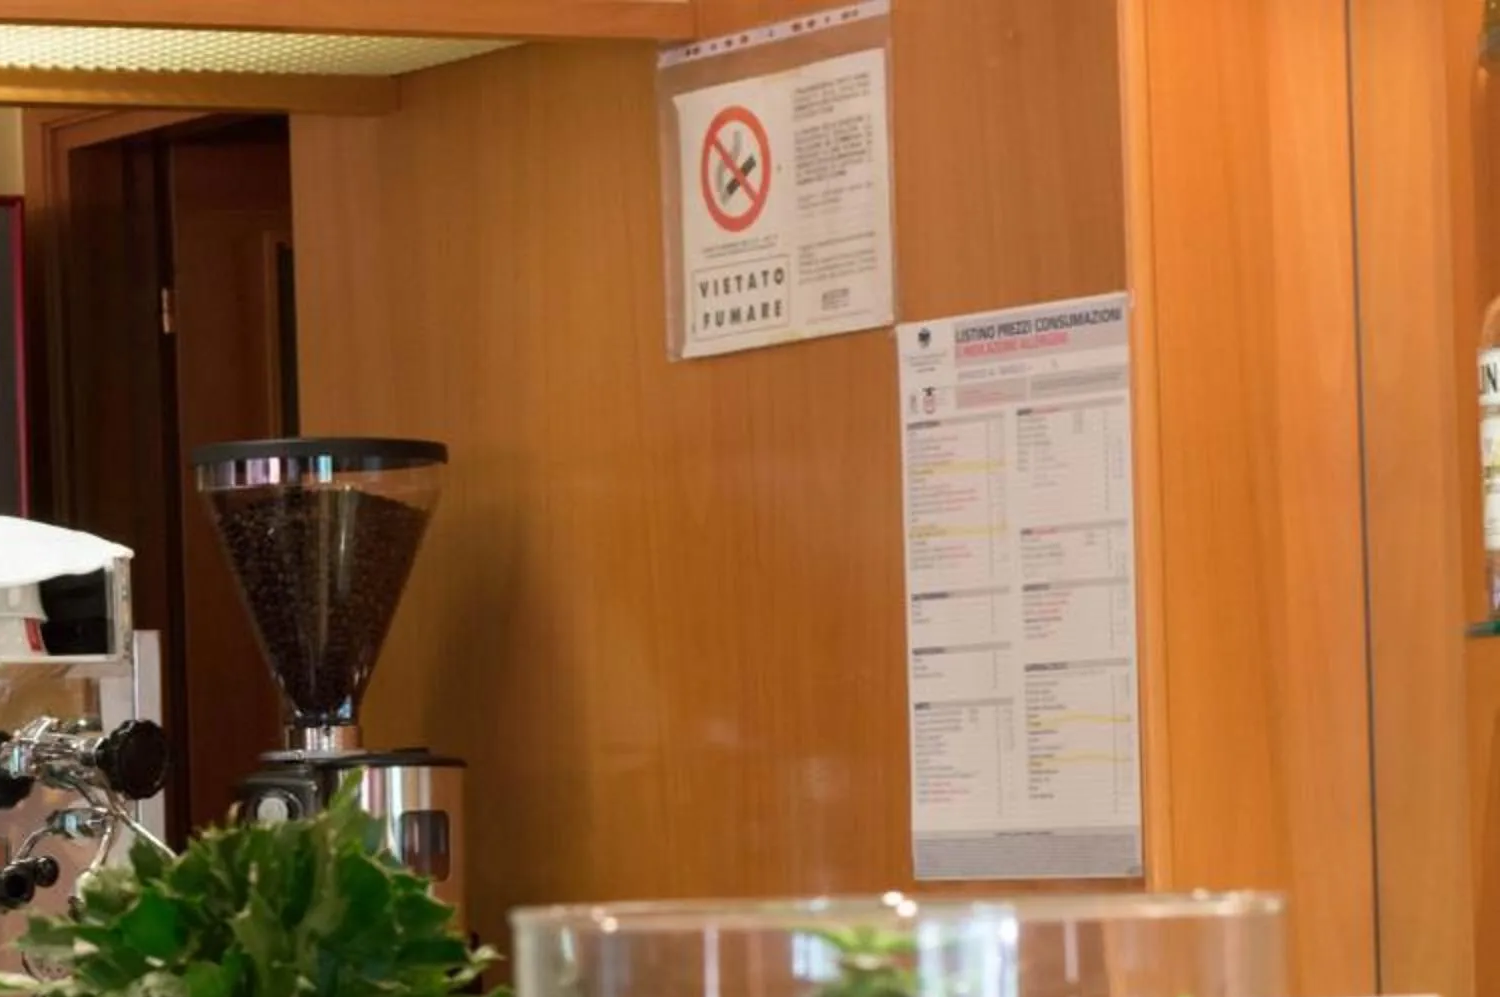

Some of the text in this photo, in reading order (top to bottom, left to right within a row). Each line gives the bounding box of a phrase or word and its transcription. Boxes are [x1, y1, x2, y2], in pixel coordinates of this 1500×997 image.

[698, 266, 785, 298] VIETATO
[702, 299, 783, 330] FUMARE
[955, 307, 1123, 343] LISTINO PREZZI CONSUMAZIONI
